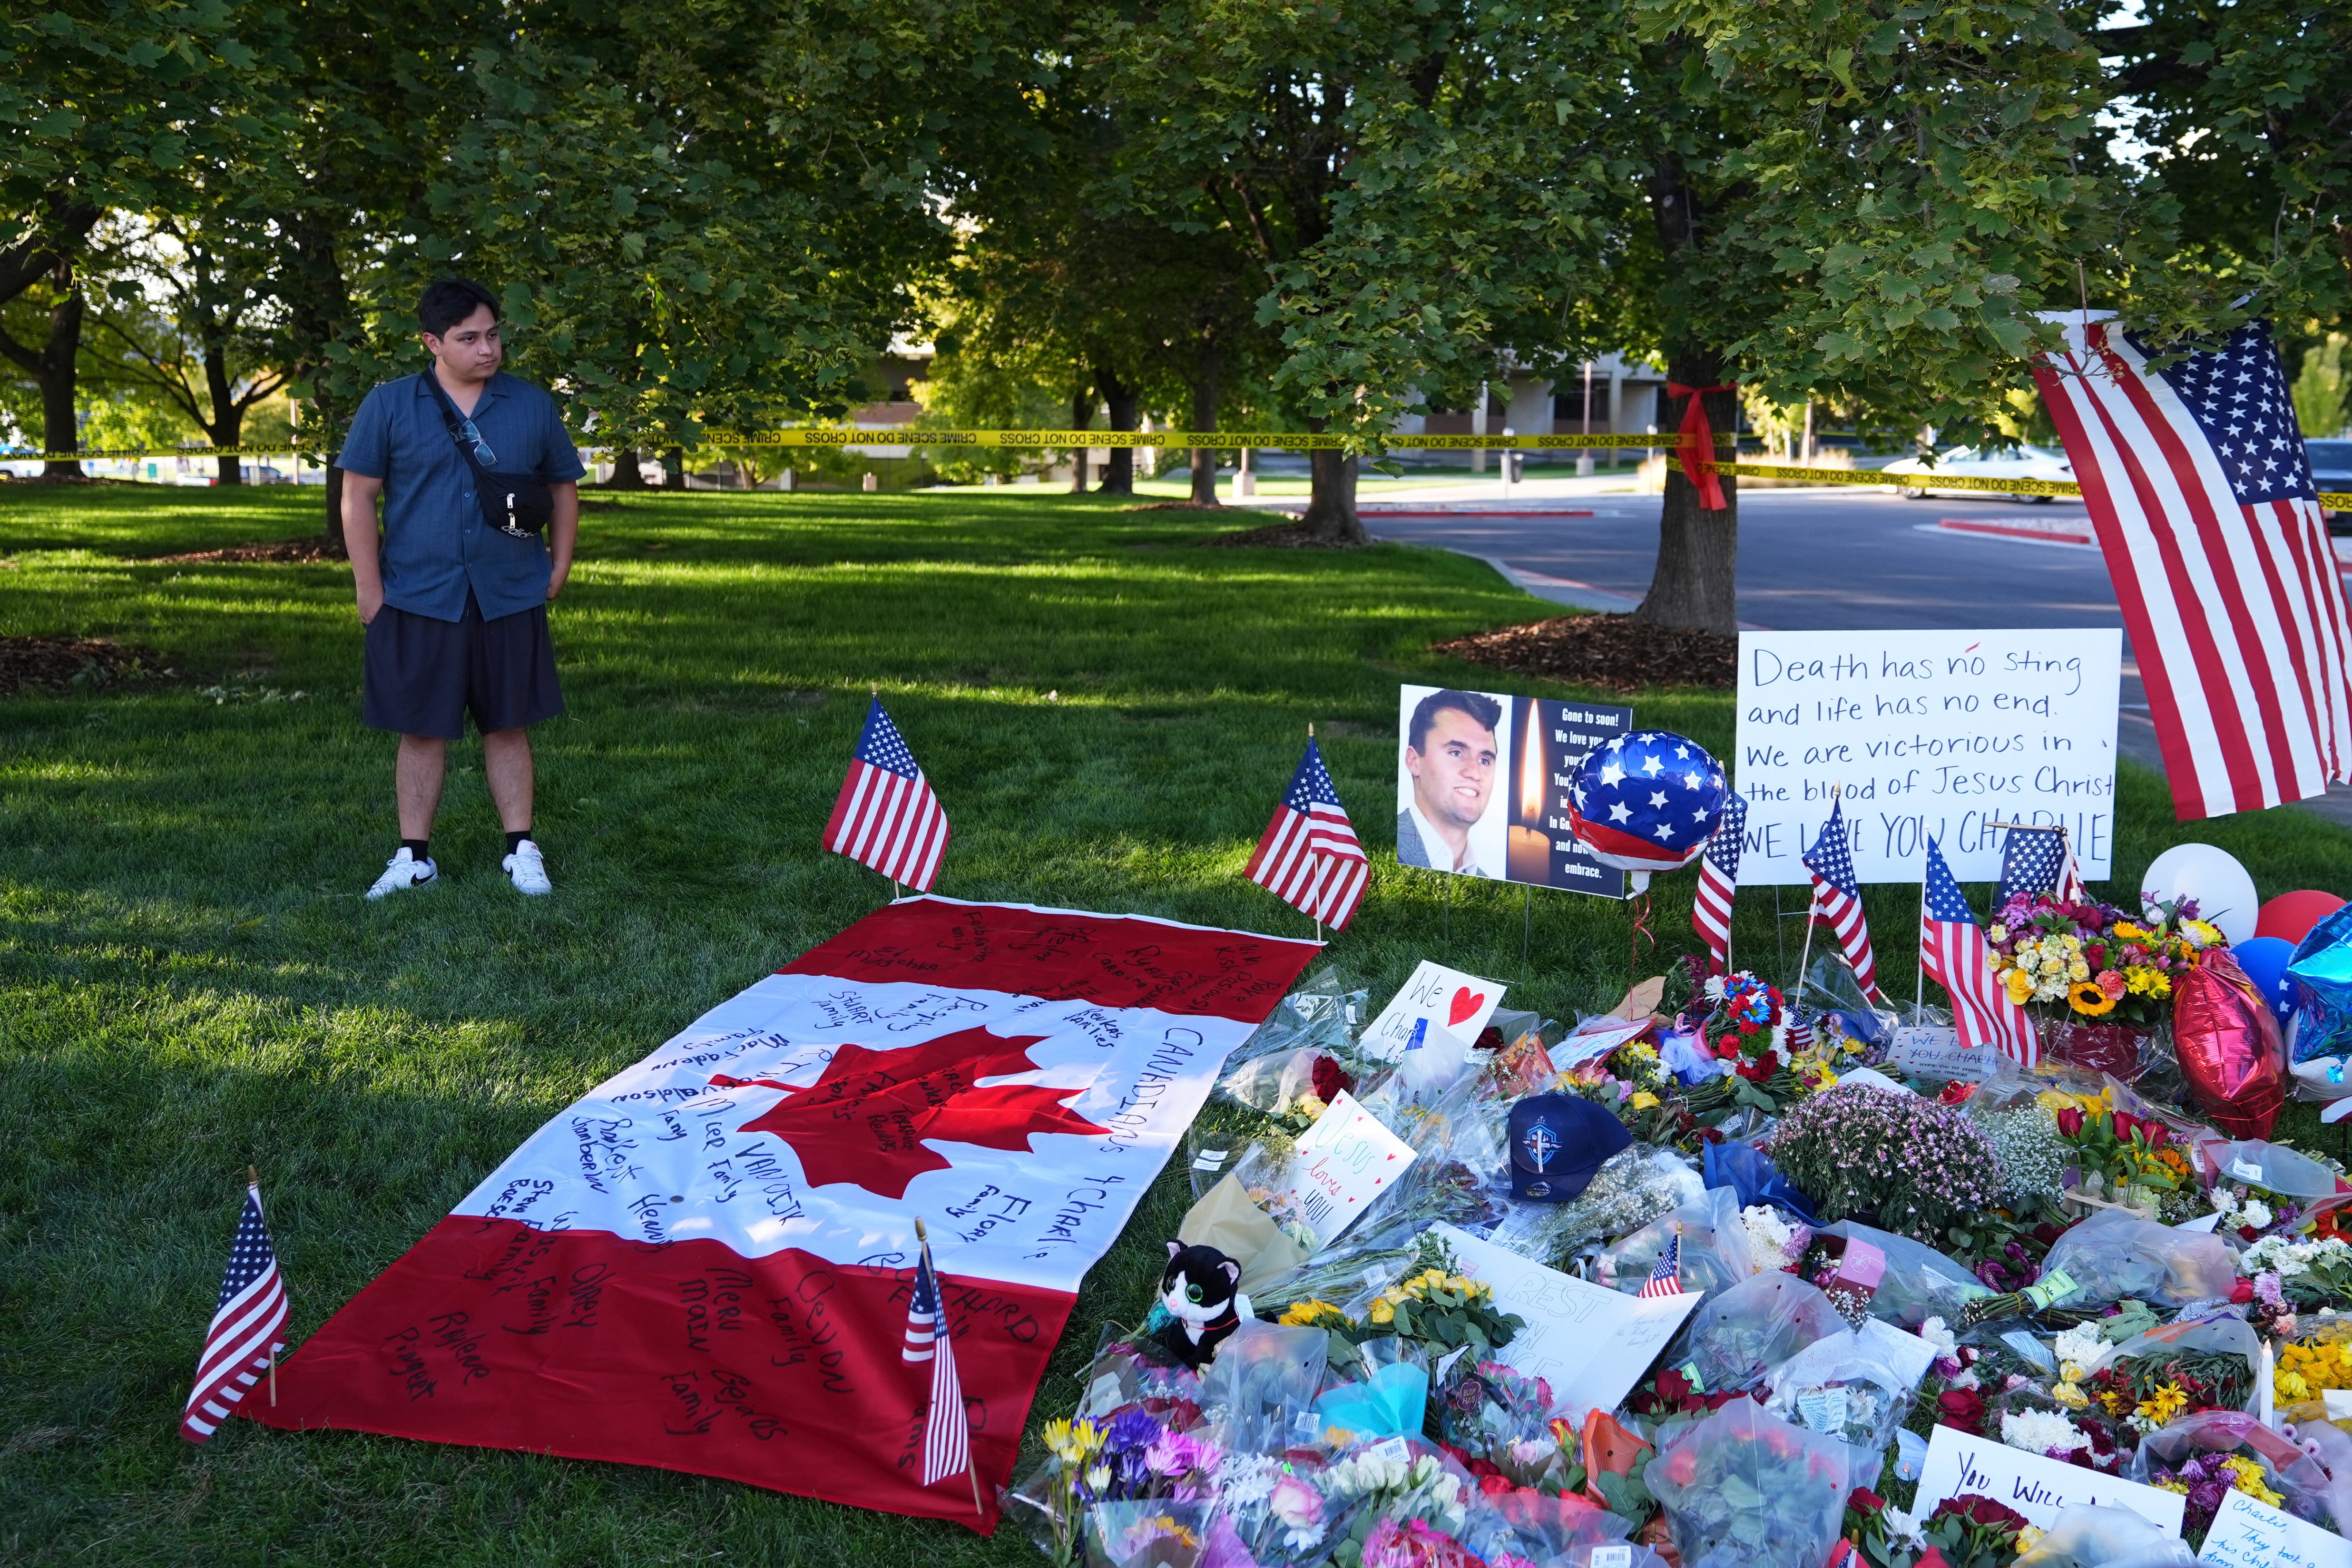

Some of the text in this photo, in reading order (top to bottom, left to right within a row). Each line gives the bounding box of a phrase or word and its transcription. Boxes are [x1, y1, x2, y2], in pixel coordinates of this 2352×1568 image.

[707, 432, 740, 444] SCEN
[805, 432, 977, 444] CRIME SCENE DO NOT CROSS
[1000, 433, 1165, 446] CRIME SCENE DO NOT CROSS
[1187, 435, 1225, 446] CROSS
[1228, 435, 1251, 446] NOT
[1254, 436, 1270, 446] DO
[1273, 436, 1309, 447] SCENE
[1431, 437, 1445, 447] DO
[1449, 437, 1484, 447] SCENE
[1486, 437, 1518, 447] CRIME
[1538, 436, 1574, 447] CROSS
[1576, 436, 1597, 447] NOT
[1598, 436, 1614, 446] DO
[1617, 436, 1649, 446] SCENE
[1777, 468, 1910, 485] CRIME SCENE DO NOT CROSS
[1930, 476, 1965, 489] CROSS
[1967, 478, 1989, 490] NOT
[1991, 480, 2007, 490] DO
[2009, 480, 2046, 493] SCENE
[1754, 648, 1867, 687] Death
[1882, 650, 1933, 681] has
[1748, 692, 2058, 725] and life has no end.
[1562, 708, 1619, 726] Gone to soon!
[1555, 729, 1568, 743] We
[1569, 731, 1587, 745] love
[1747, 730, 2072, 767] We are victorious in
[1744, 782, 1787, 802] the
[1888, 768, 1920, 795] of
[1932, 765, 2024, 795] Jesus
[2034, 765, 2114, 796] Christ
[1549, 815, 1558, 829] In
[1556, 840, 1571, 853] and
[1565, 862, 1602, 879] embrace.
[1409, 971, 1443, 1008] We
[1912, 1035, 1941, 1046] WE
[1315, 1105, 1376, 1175] Jesus
[1504, 1272, 1613, 1323] REST
